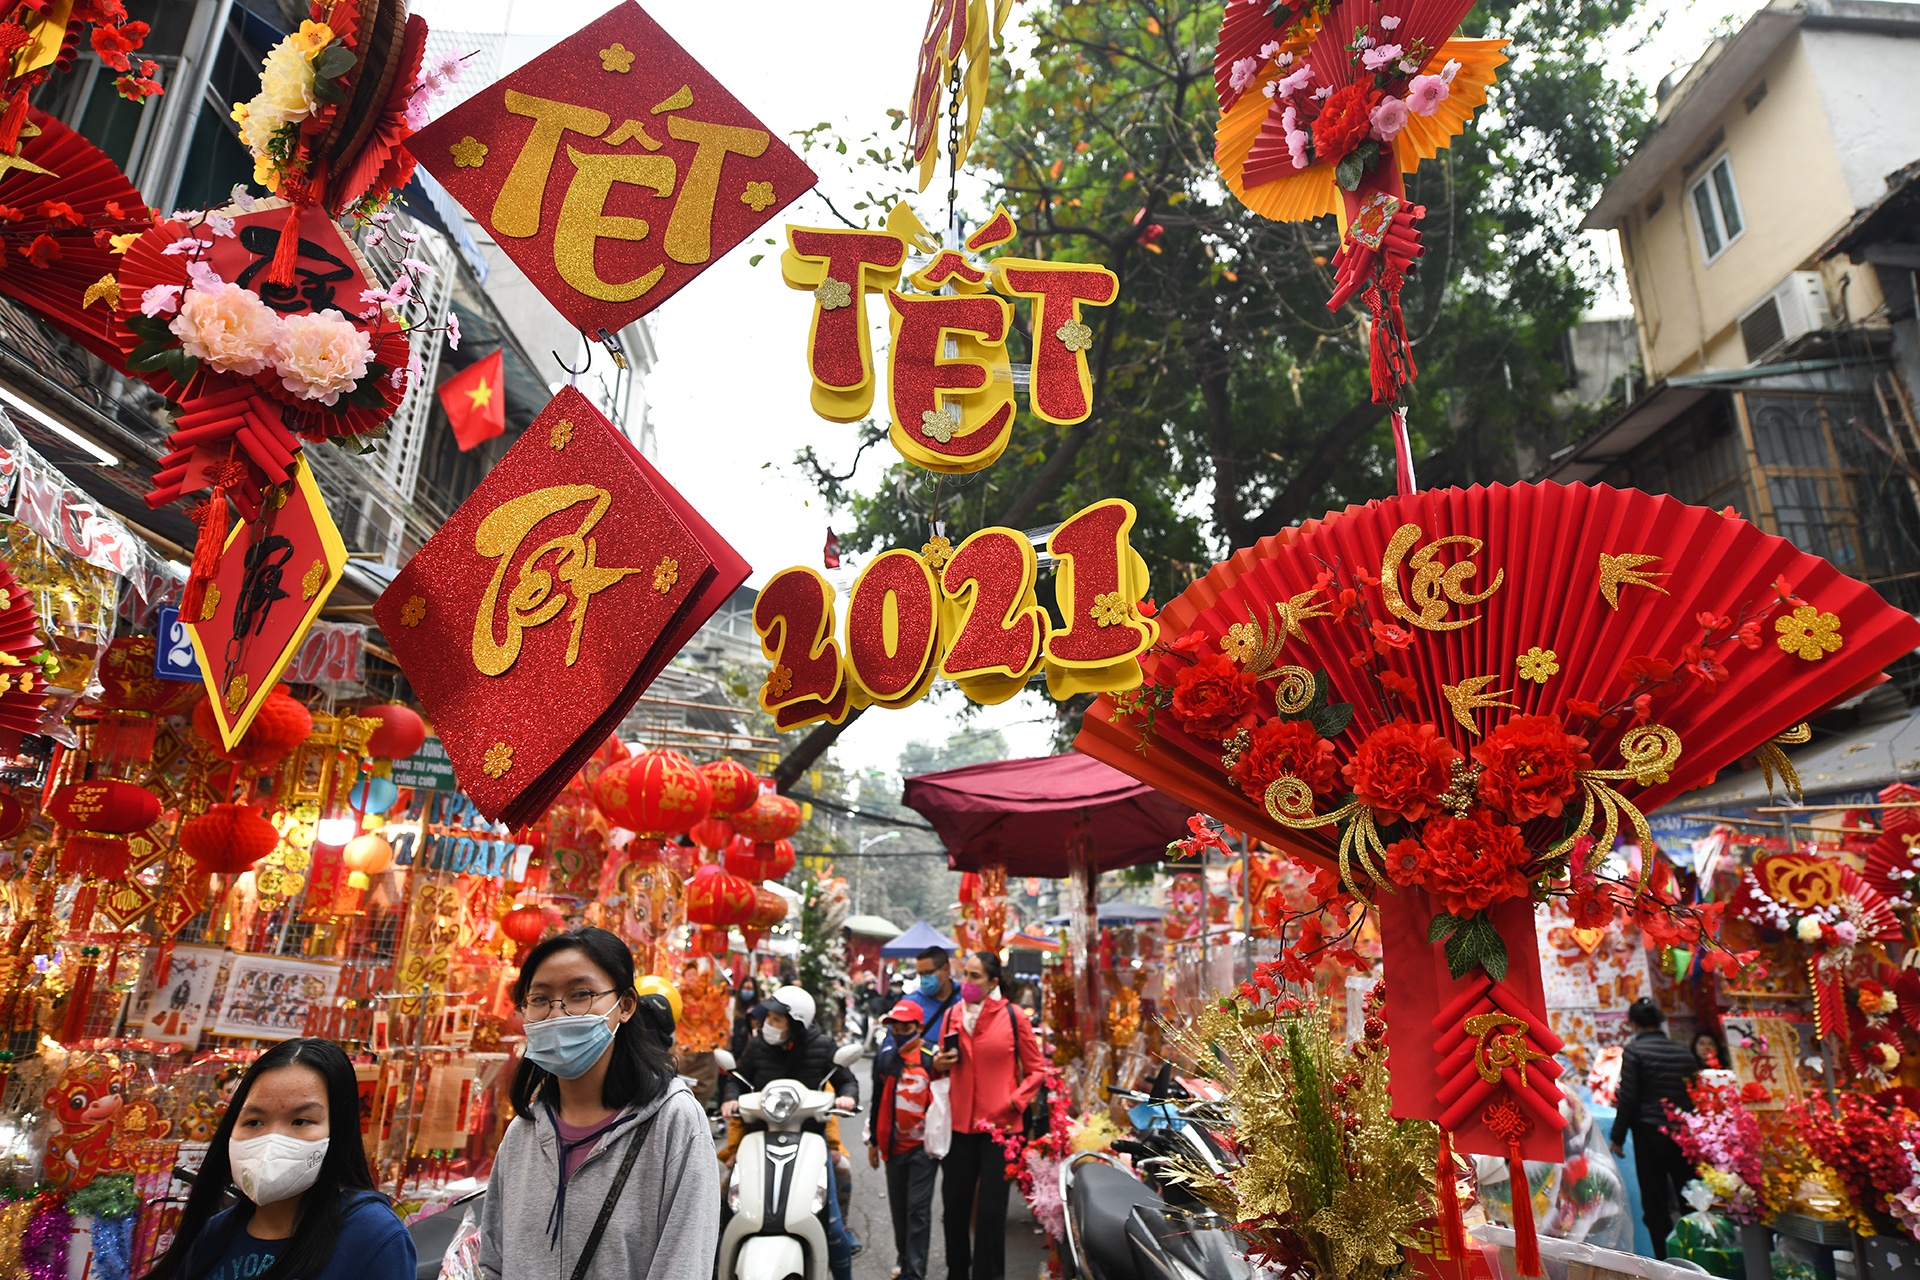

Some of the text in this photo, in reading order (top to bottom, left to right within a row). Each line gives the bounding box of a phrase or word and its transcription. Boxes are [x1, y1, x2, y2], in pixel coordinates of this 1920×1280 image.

[490, 84, 771, 303] TẾT
[783, 202, 1120, 464] TẾT
[168, 621, 200, 668] 2
[753, 498, 1156, 722] 2021
[231, 1252, 277, 1280] YOR
